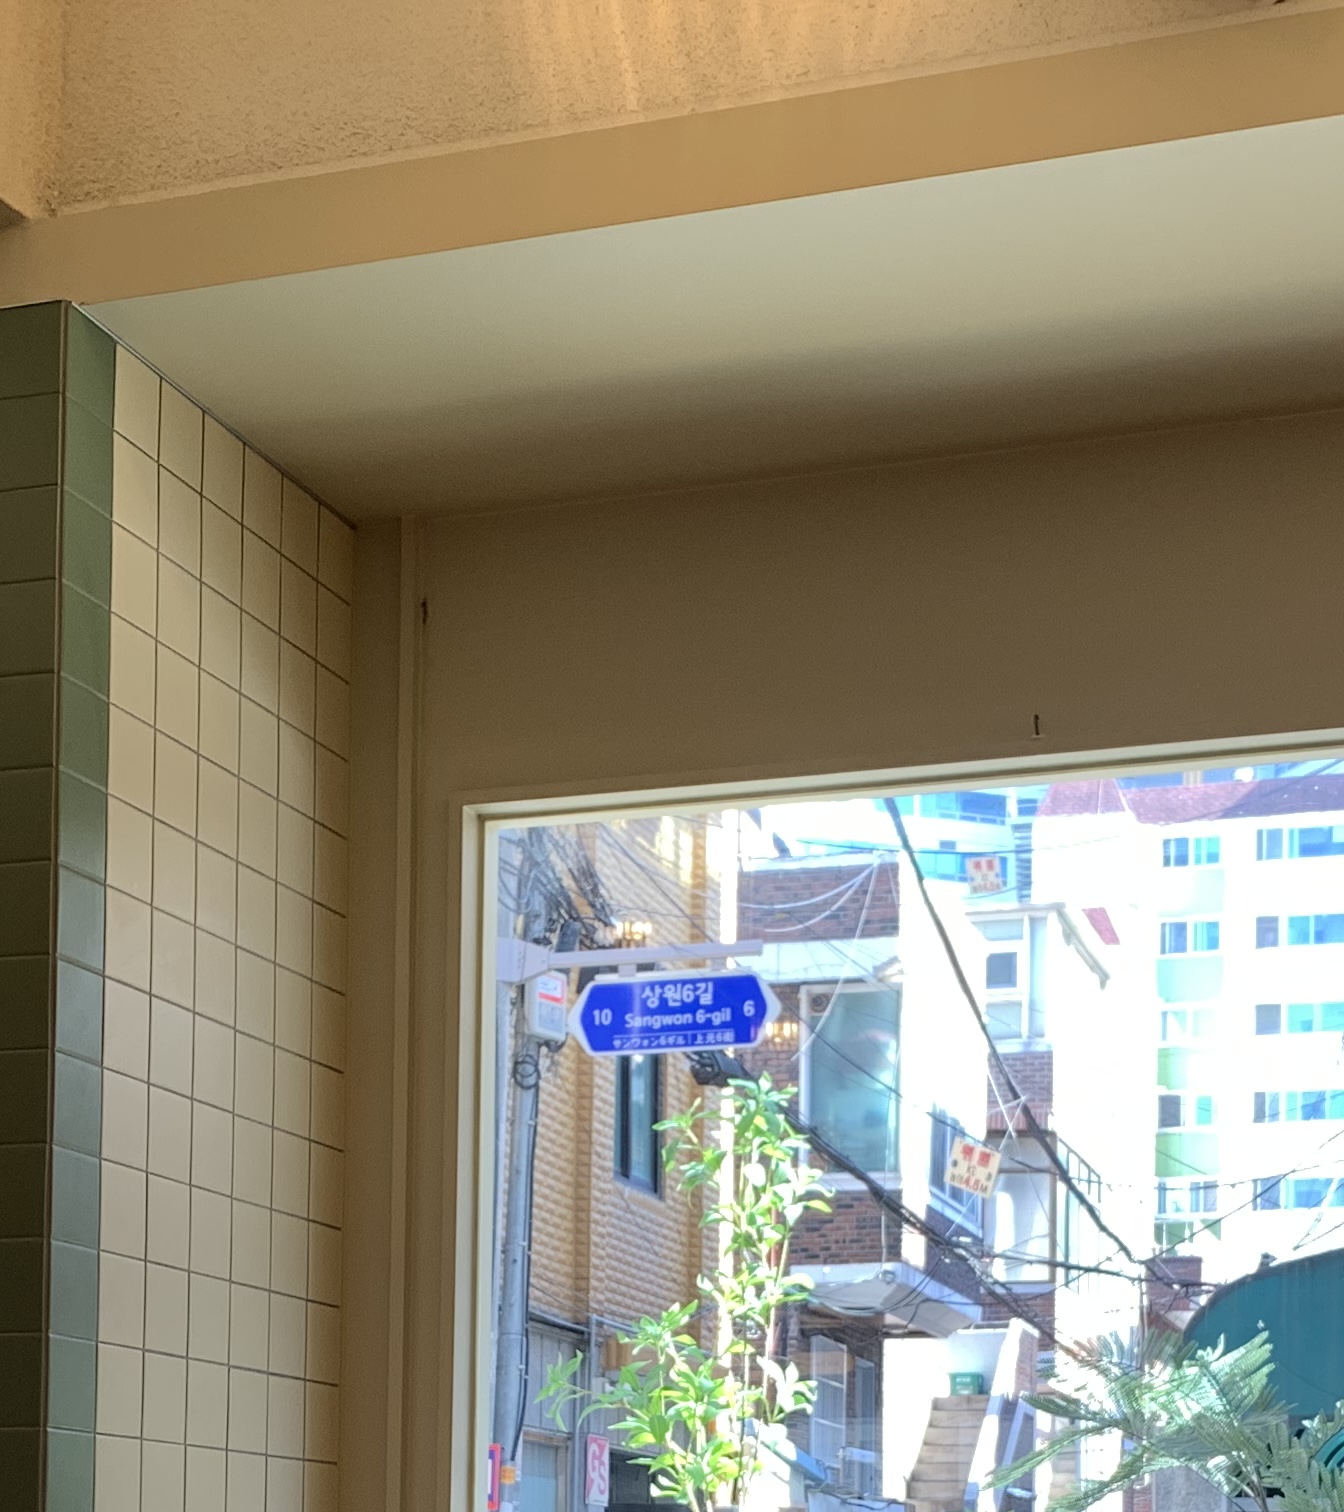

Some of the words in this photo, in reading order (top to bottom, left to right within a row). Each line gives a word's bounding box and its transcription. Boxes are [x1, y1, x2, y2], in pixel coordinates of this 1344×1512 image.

[641, 981, 714, 1008] 상원6길
[593, 1009, 613, 1026] 10
[624, 1011, 693, 1030] Sangwon
[695, 1007, 732, 1026] 6-gil
[743, 1000, 755, 1017] 6
